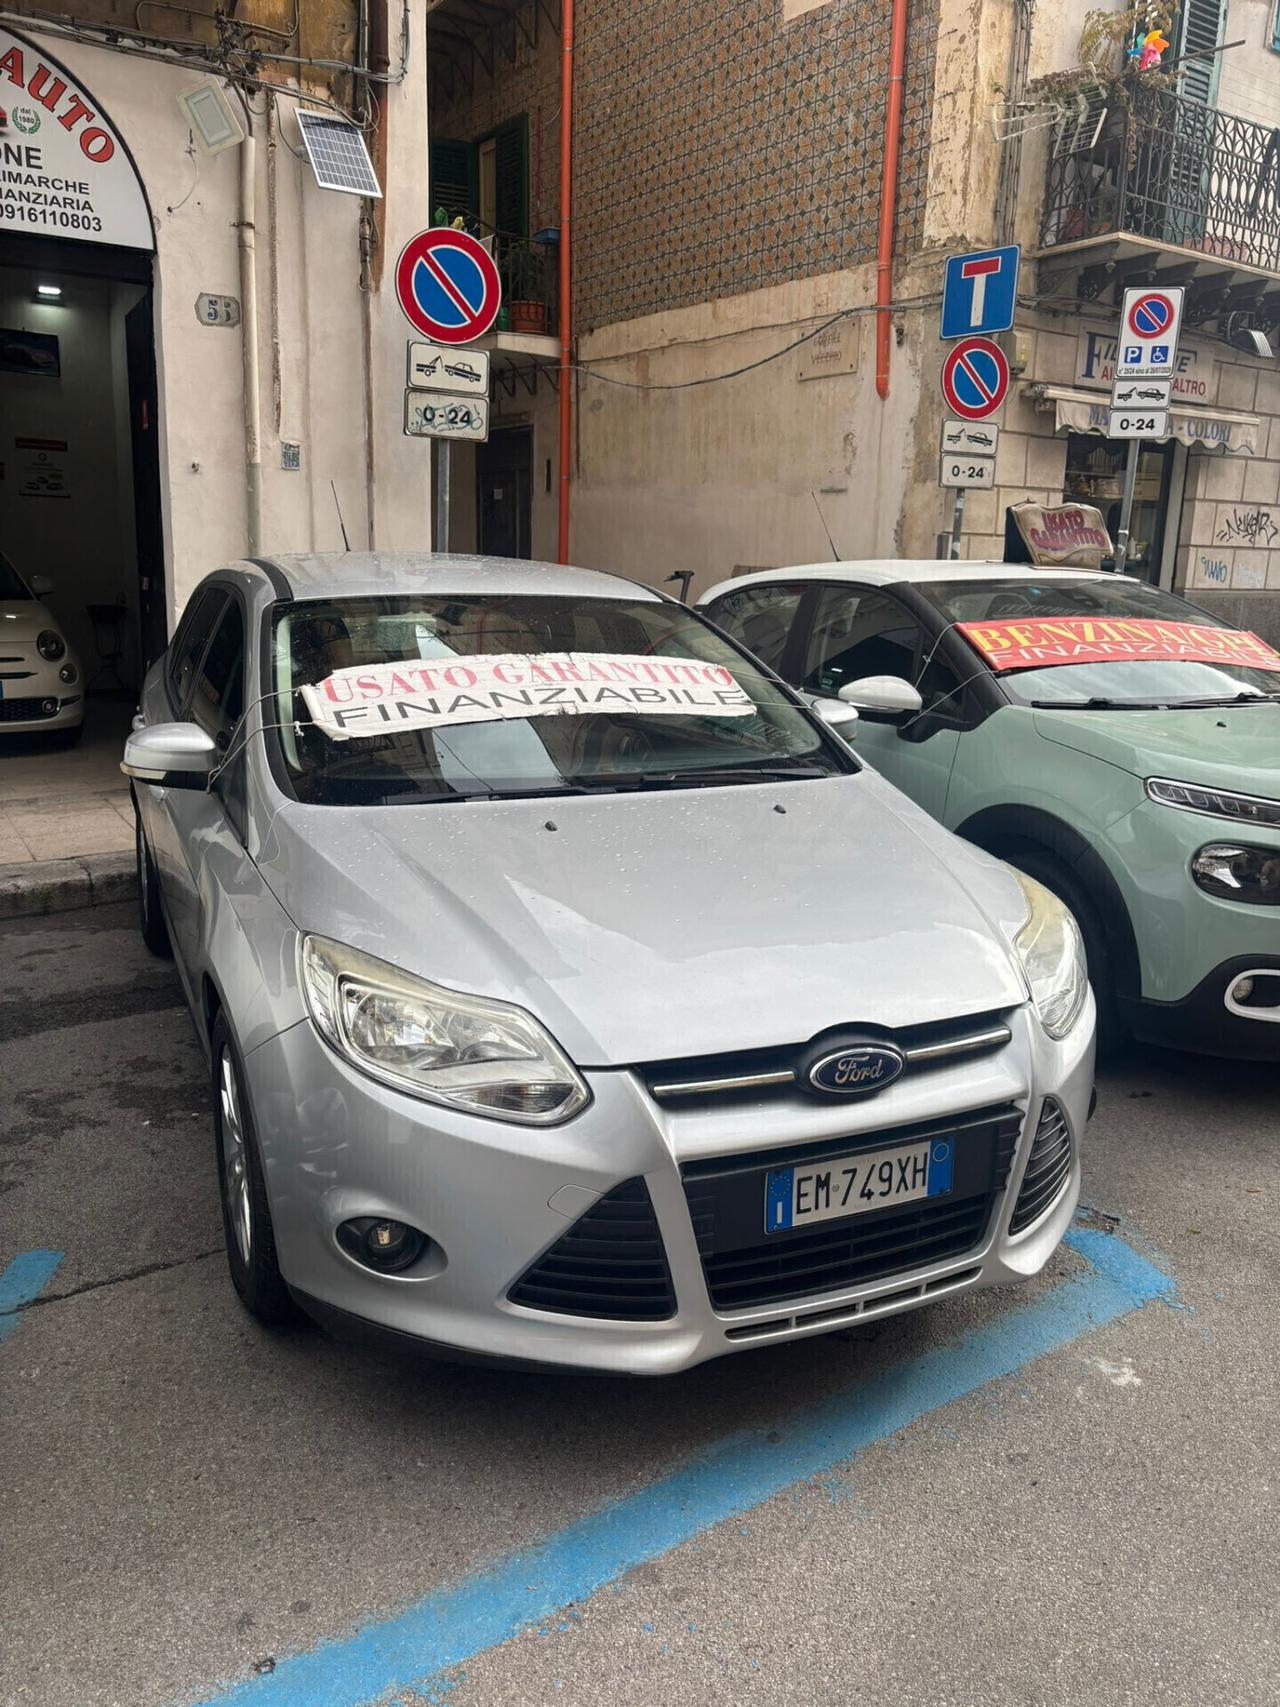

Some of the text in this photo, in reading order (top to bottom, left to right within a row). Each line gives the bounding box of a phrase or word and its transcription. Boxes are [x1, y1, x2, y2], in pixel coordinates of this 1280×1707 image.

[0, 46, 115, 162] AUTO
[20, 106, 31, 114] dal
[19, 115, 35, 124] 1980
[0, 143, 43, 170] NE
[0, 170, 90, 195] IMARCHE
[0, 187, 95, 213] ANZIARIA
[1120, 418, 1155, 431] 0-24
[1187, 418, 1232, 442] COLORI
[952, 465, 984, 479] 0-24
[1041, 509, 1085, 532] USATO
[323, 660, 734, 703] USATO GARANTITO
[333, 687, 753, 728] FINANZIABILE
[834, 1055, 885, 1085] Ford
